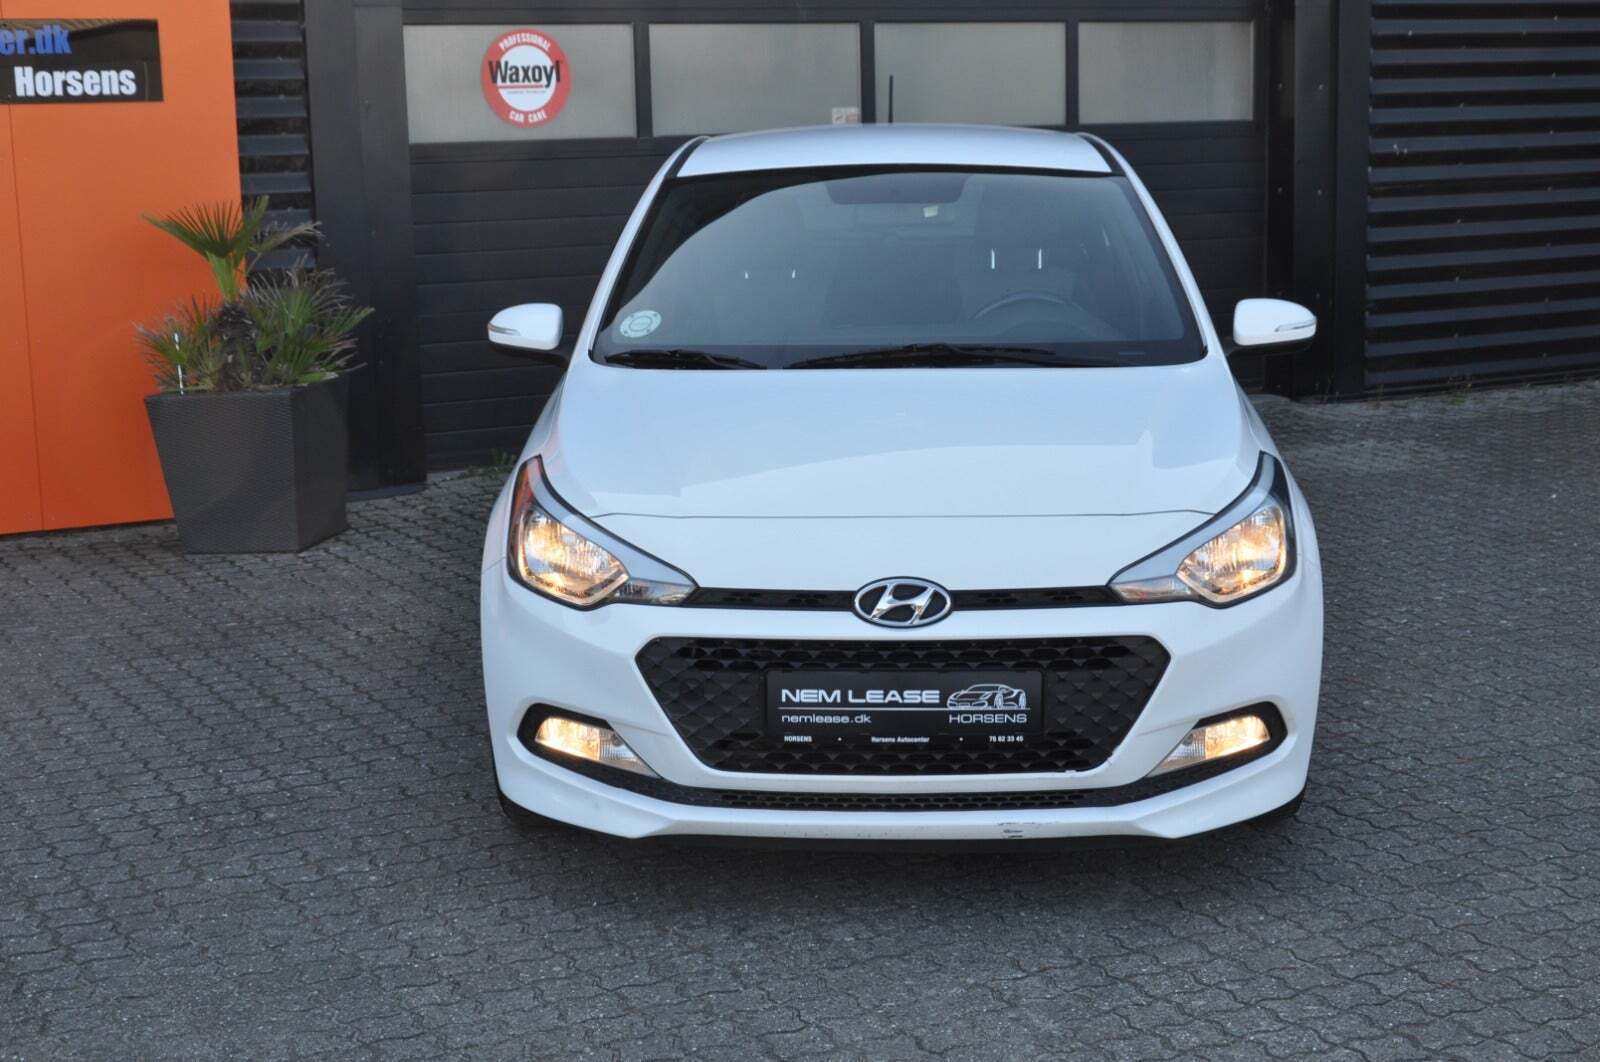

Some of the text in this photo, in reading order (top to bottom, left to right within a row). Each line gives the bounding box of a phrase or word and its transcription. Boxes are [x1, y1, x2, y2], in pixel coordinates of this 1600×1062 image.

[499, 32, 551, 51] PROFESSIONAL
[488, 60, 560, 88] Waxoyl
[14, 66, 136, 97] Horsens
[509, 109, 547, 123] CAR CARE
[781, 689, 940, 703] NEM LEASE
[781, 714, 872, 723] nemlease.dk
[949, 714, 1027, 723] HORSENS
